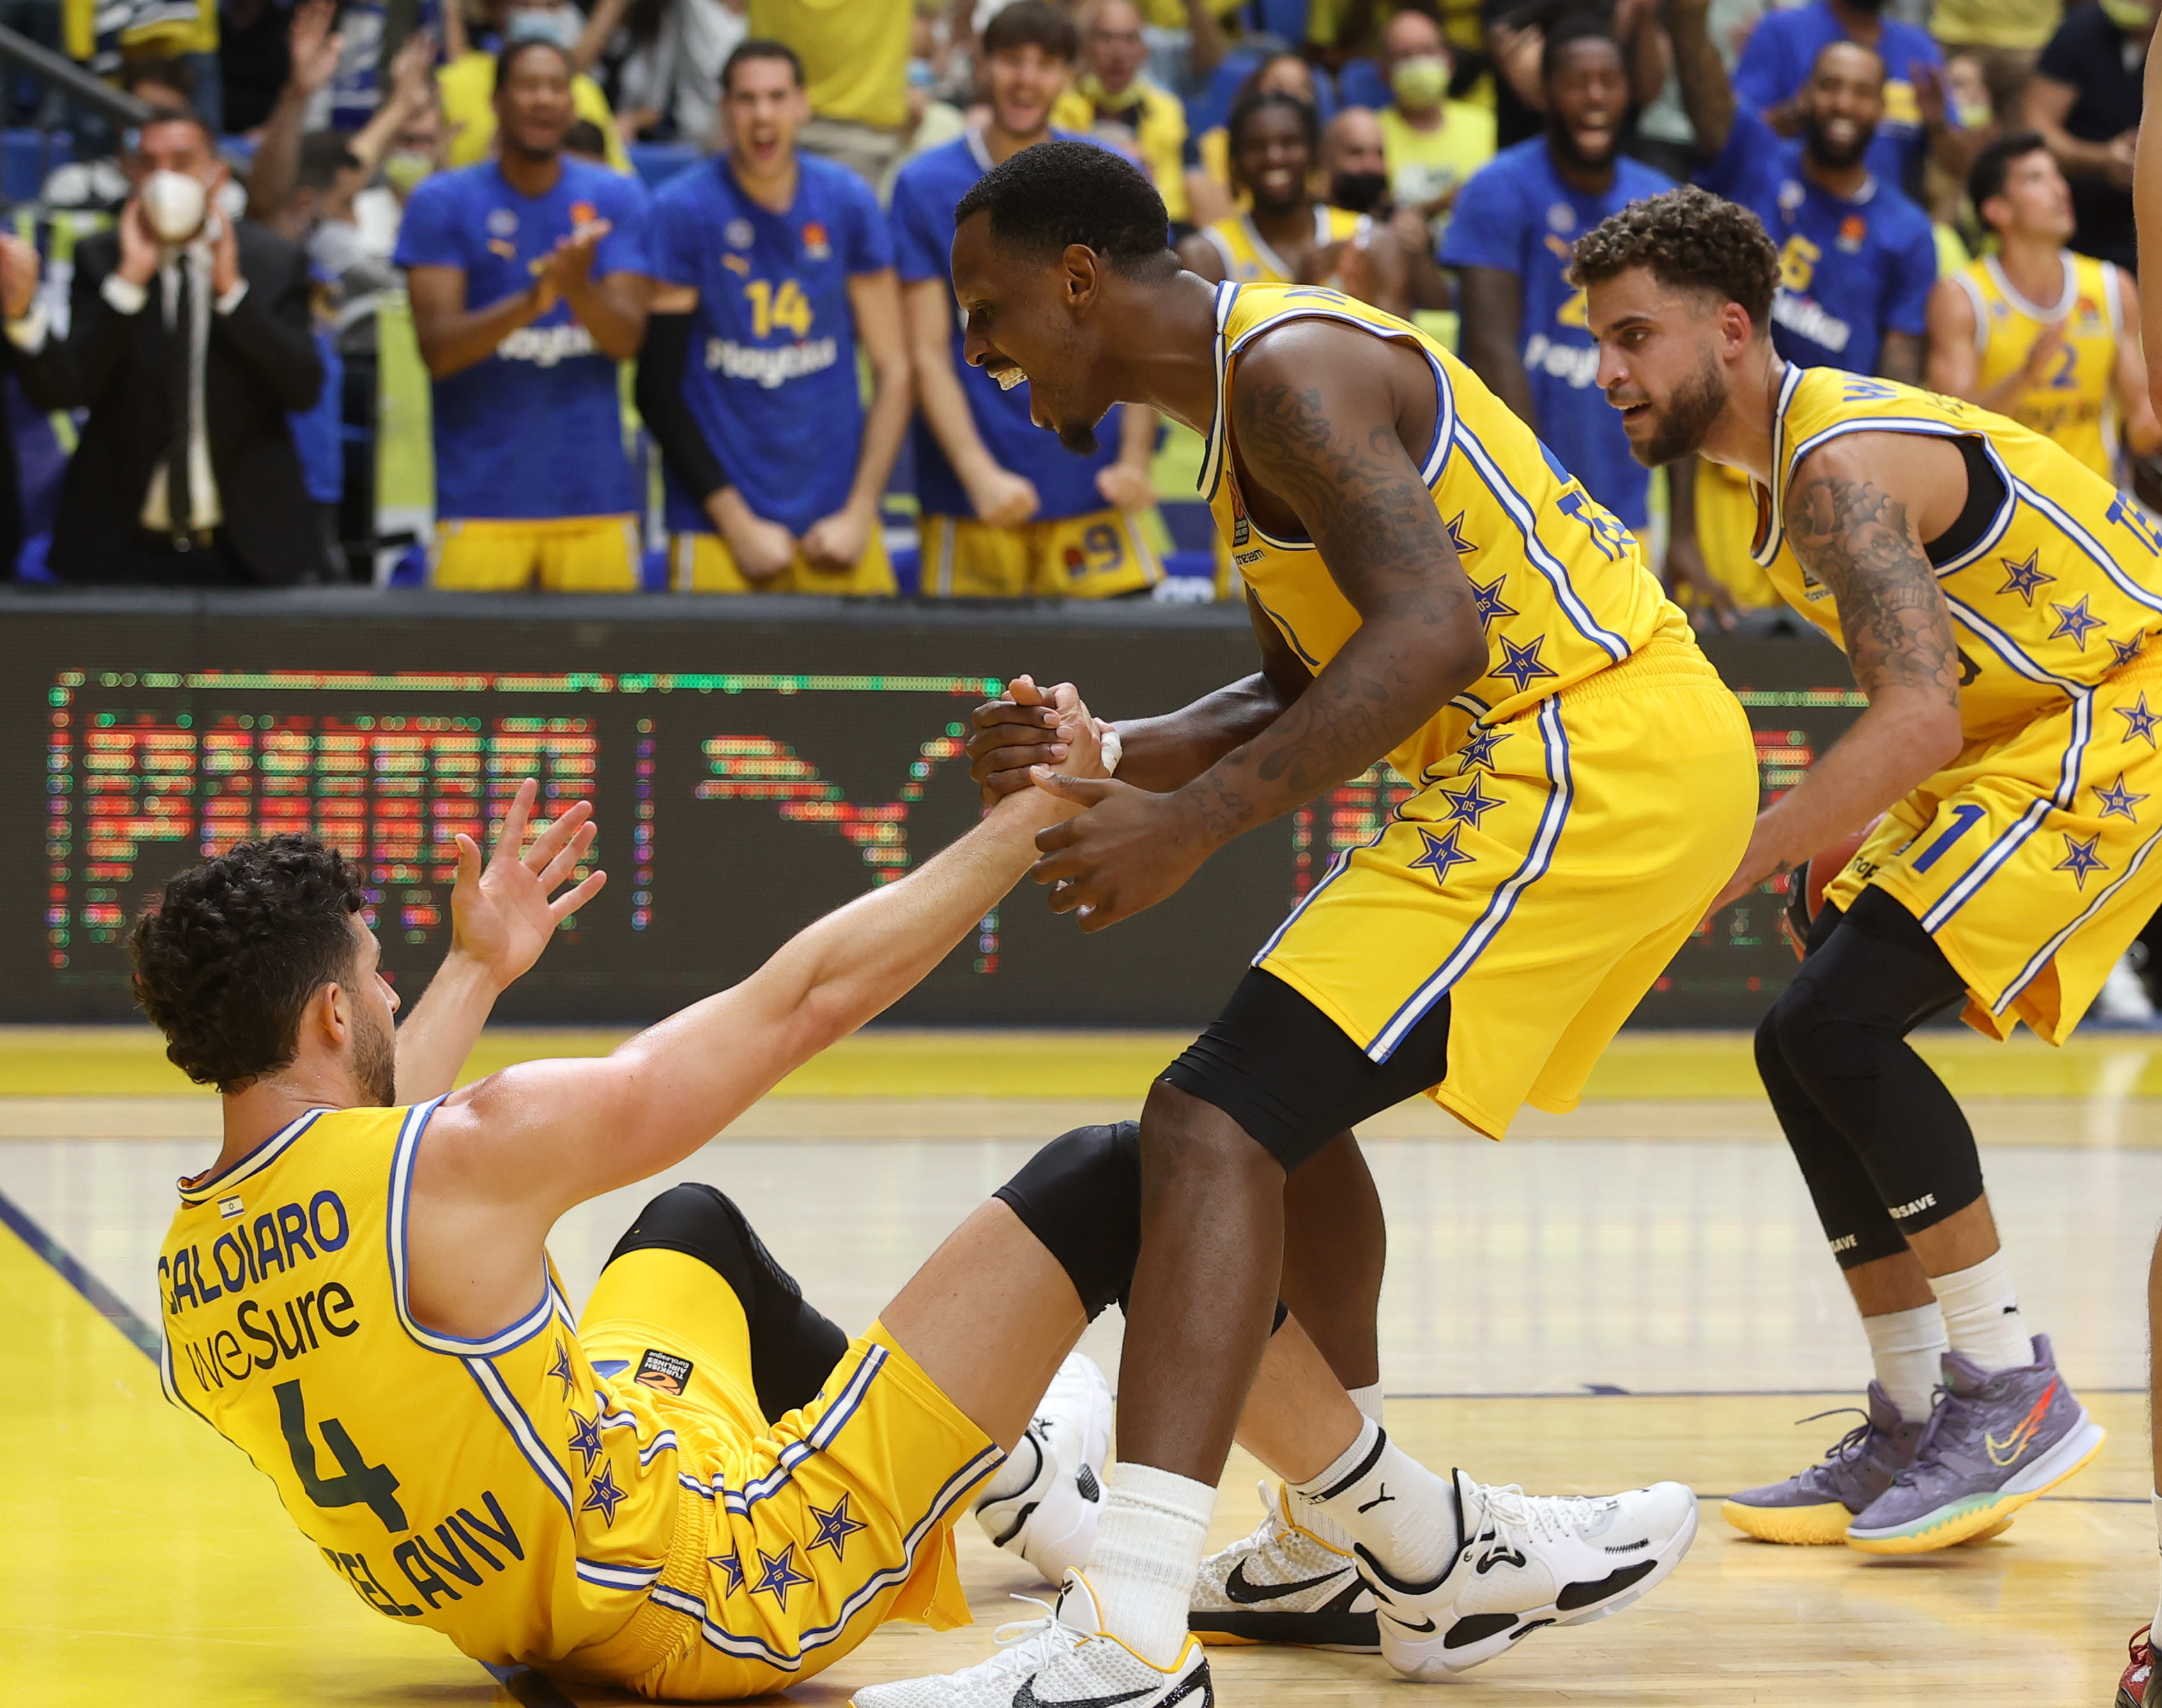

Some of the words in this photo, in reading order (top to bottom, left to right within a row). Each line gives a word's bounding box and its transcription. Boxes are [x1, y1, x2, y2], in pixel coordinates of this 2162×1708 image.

[744, 278, 814, 340] 14
[1515, 658, 1529, 672] 14
[1473, 743, 1486, 755] 04
[1461, 800, 1476, 812] 05
[1436, 848, 1448, 861] 14
[1912, 805, 1986, 874] 1
[158, 1190, 349, 1315] CALOIARO
[185, 1282, 360, 1392] weSure
[644, 1362, 684, 1380] TURKISH
[647, 1357, 687, 1375] AIRLINES
[272, 1379, 410, 1533] 4
[393, 1490, 525, 1610] AVIV
